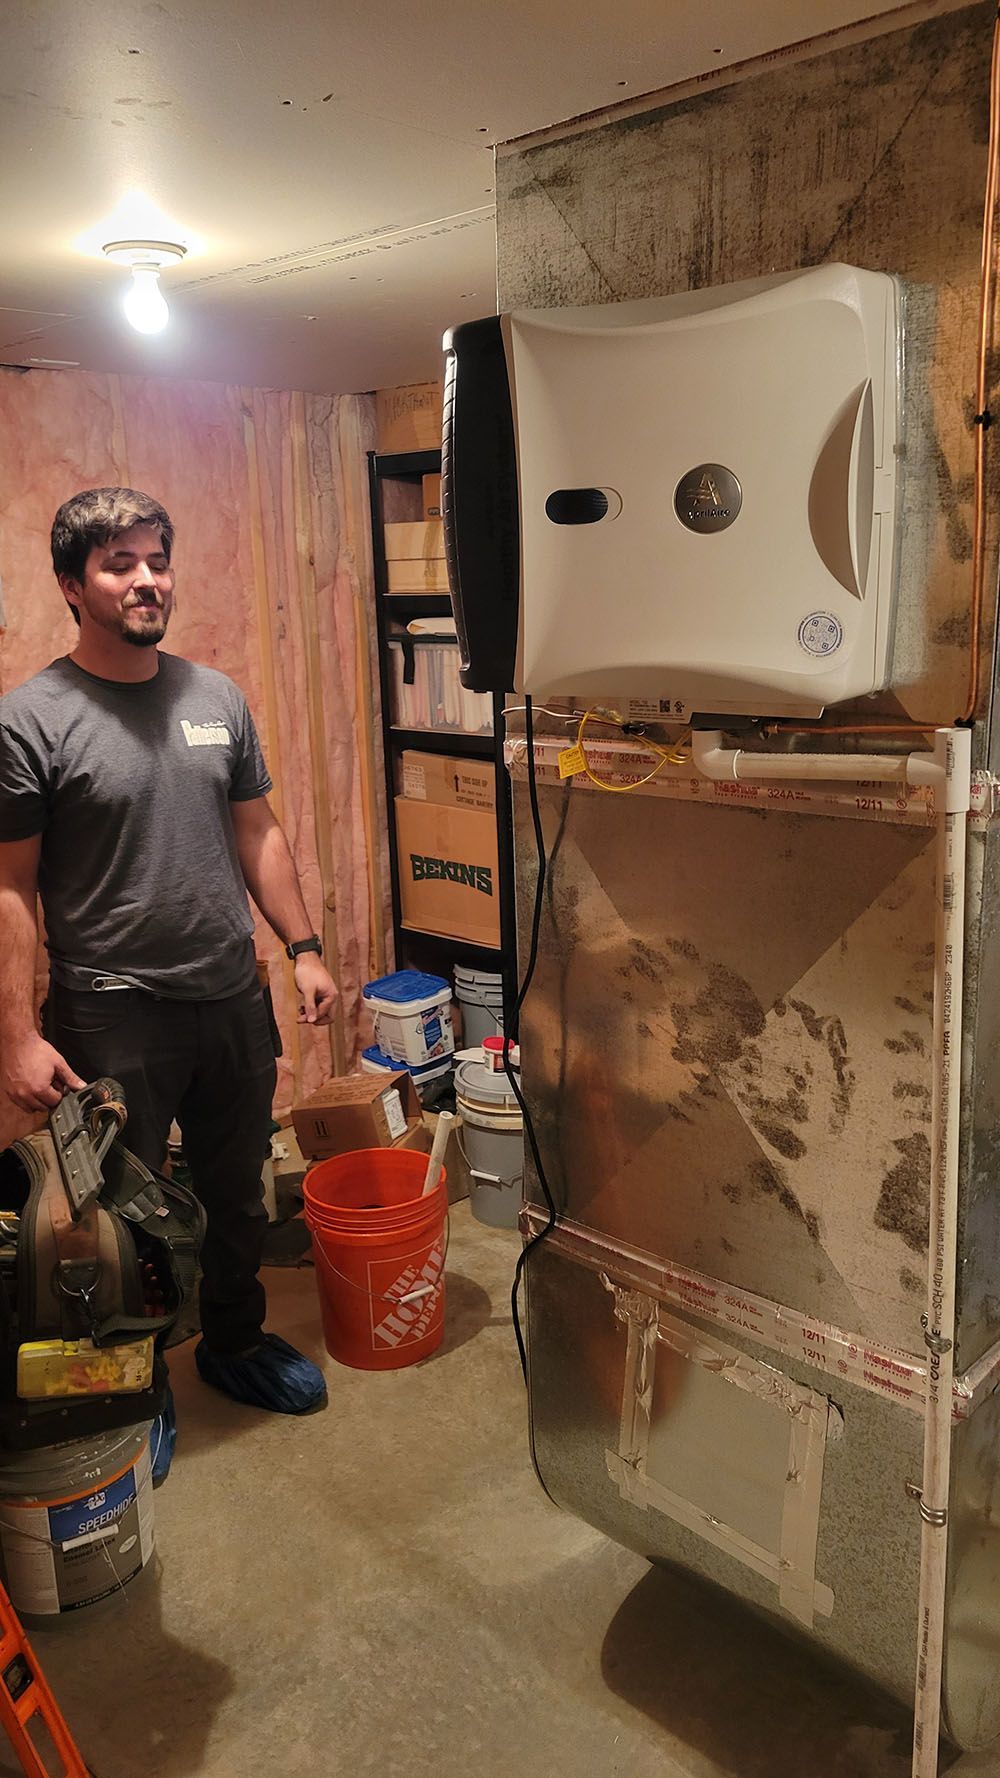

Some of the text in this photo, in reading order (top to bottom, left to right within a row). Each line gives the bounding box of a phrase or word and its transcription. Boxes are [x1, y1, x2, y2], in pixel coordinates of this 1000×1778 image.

[620, 752, 642, 765] 324A
[767, 788, 795, 801] 324A
[855, 799, 883, 811] 12/11
[409, 854, 493, 897] BEKINS
[381, 1264, 420, 1304] THE
[932, 1273, 943, 1288] 40
[724, 1295, 749, 1312] 324A
[932, 1290, 944, 1310] SCH
[725, 1313, 750, 1330] 324A
[802, 1328, 826, 1344] 12/11
[802, 1347, 826, 1363] 12/11
[863, 1348, 913, 1378] Nashua
[863, 1369, 913, 1397] Nashua
